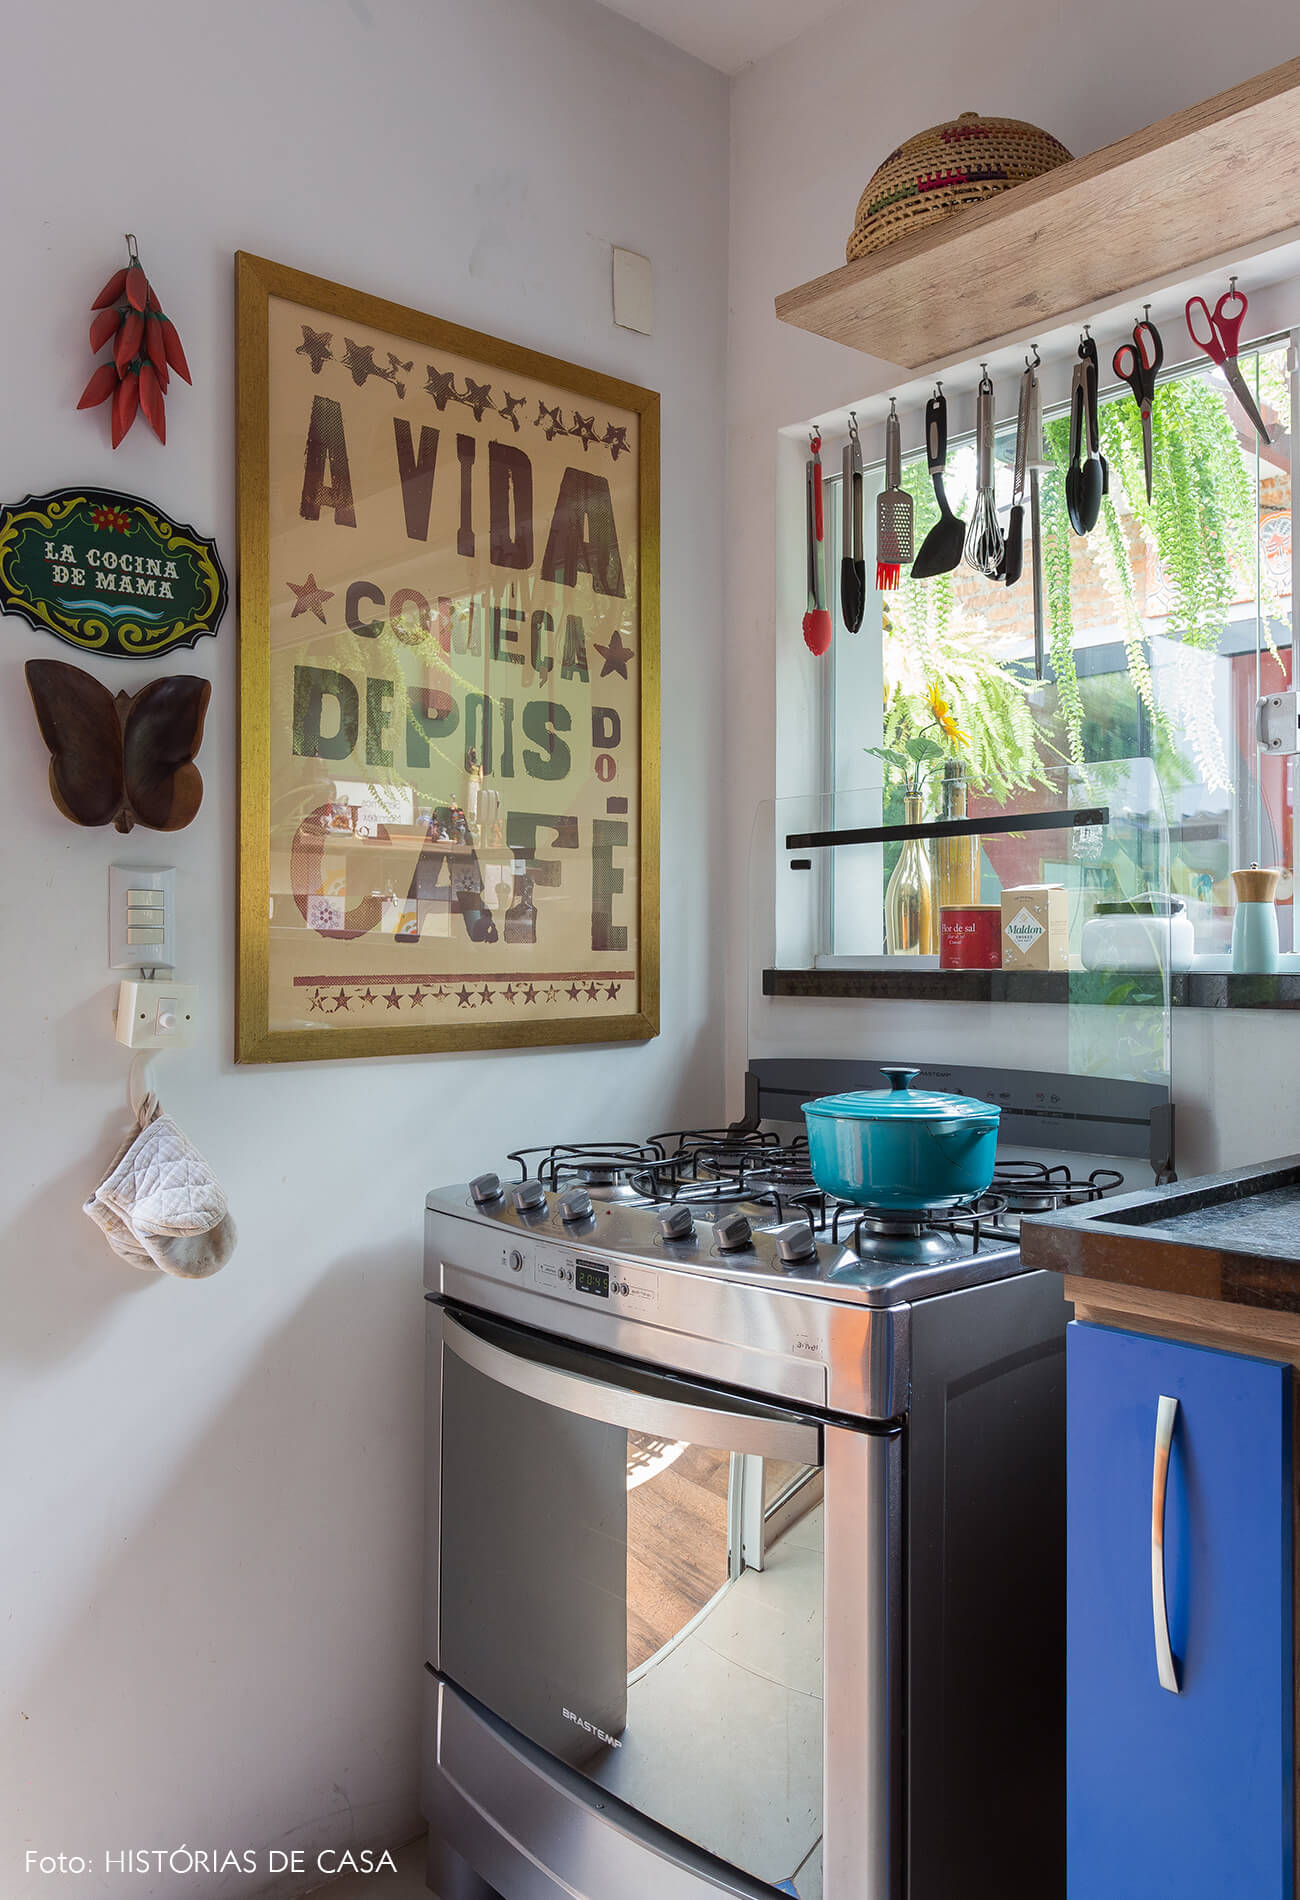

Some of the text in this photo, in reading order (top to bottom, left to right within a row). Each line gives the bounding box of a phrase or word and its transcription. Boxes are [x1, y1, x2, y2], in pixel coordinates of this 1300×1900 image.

[299, 394, 627, 599] A VIDA
[44, 541, 180, 580] LA COCINA
[51, 564, 175, 599] DE MAMA
[345, 580, 590, 689] COMEÇA
[292, 664, 572, 781] DEPOIS
[289, 796, 629, 951] CAFÉ
[953, 922, 963, 932] de
[964, 922, 976, 932] sal
[1007, 924, 1042, 935] Maldon
[578, 1272, 609, 1290] 20:45
[562, 1706, 623, 1749] BRASTEMP
